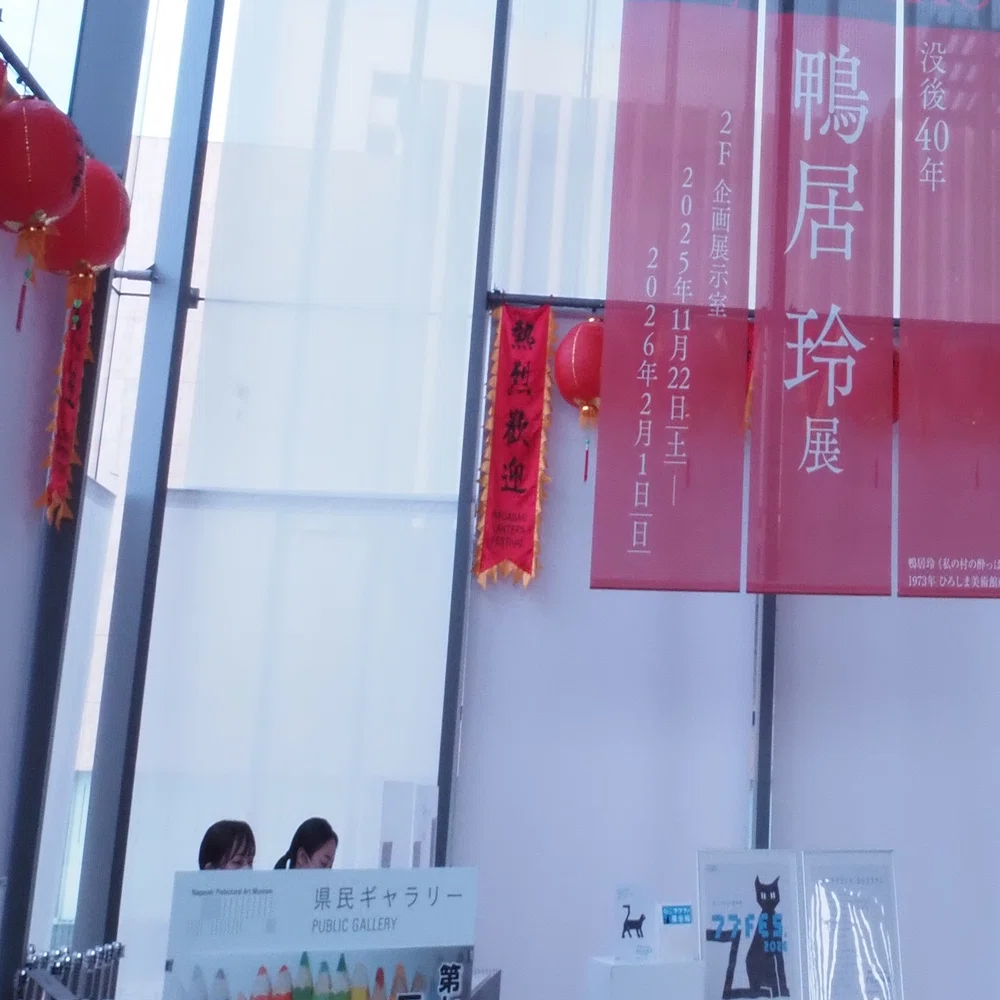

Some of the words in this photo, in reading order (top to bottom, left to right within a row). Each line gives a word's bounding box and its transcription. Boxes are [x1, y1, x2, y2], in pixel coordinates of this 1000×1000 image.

[914, 41, 949, 193] 没後40年
[313, 885, 463, 911] 県民ギャラリー
[312, 918, 349, 934] PUBLIC
[351, 917, 398, 932] GALLERY
